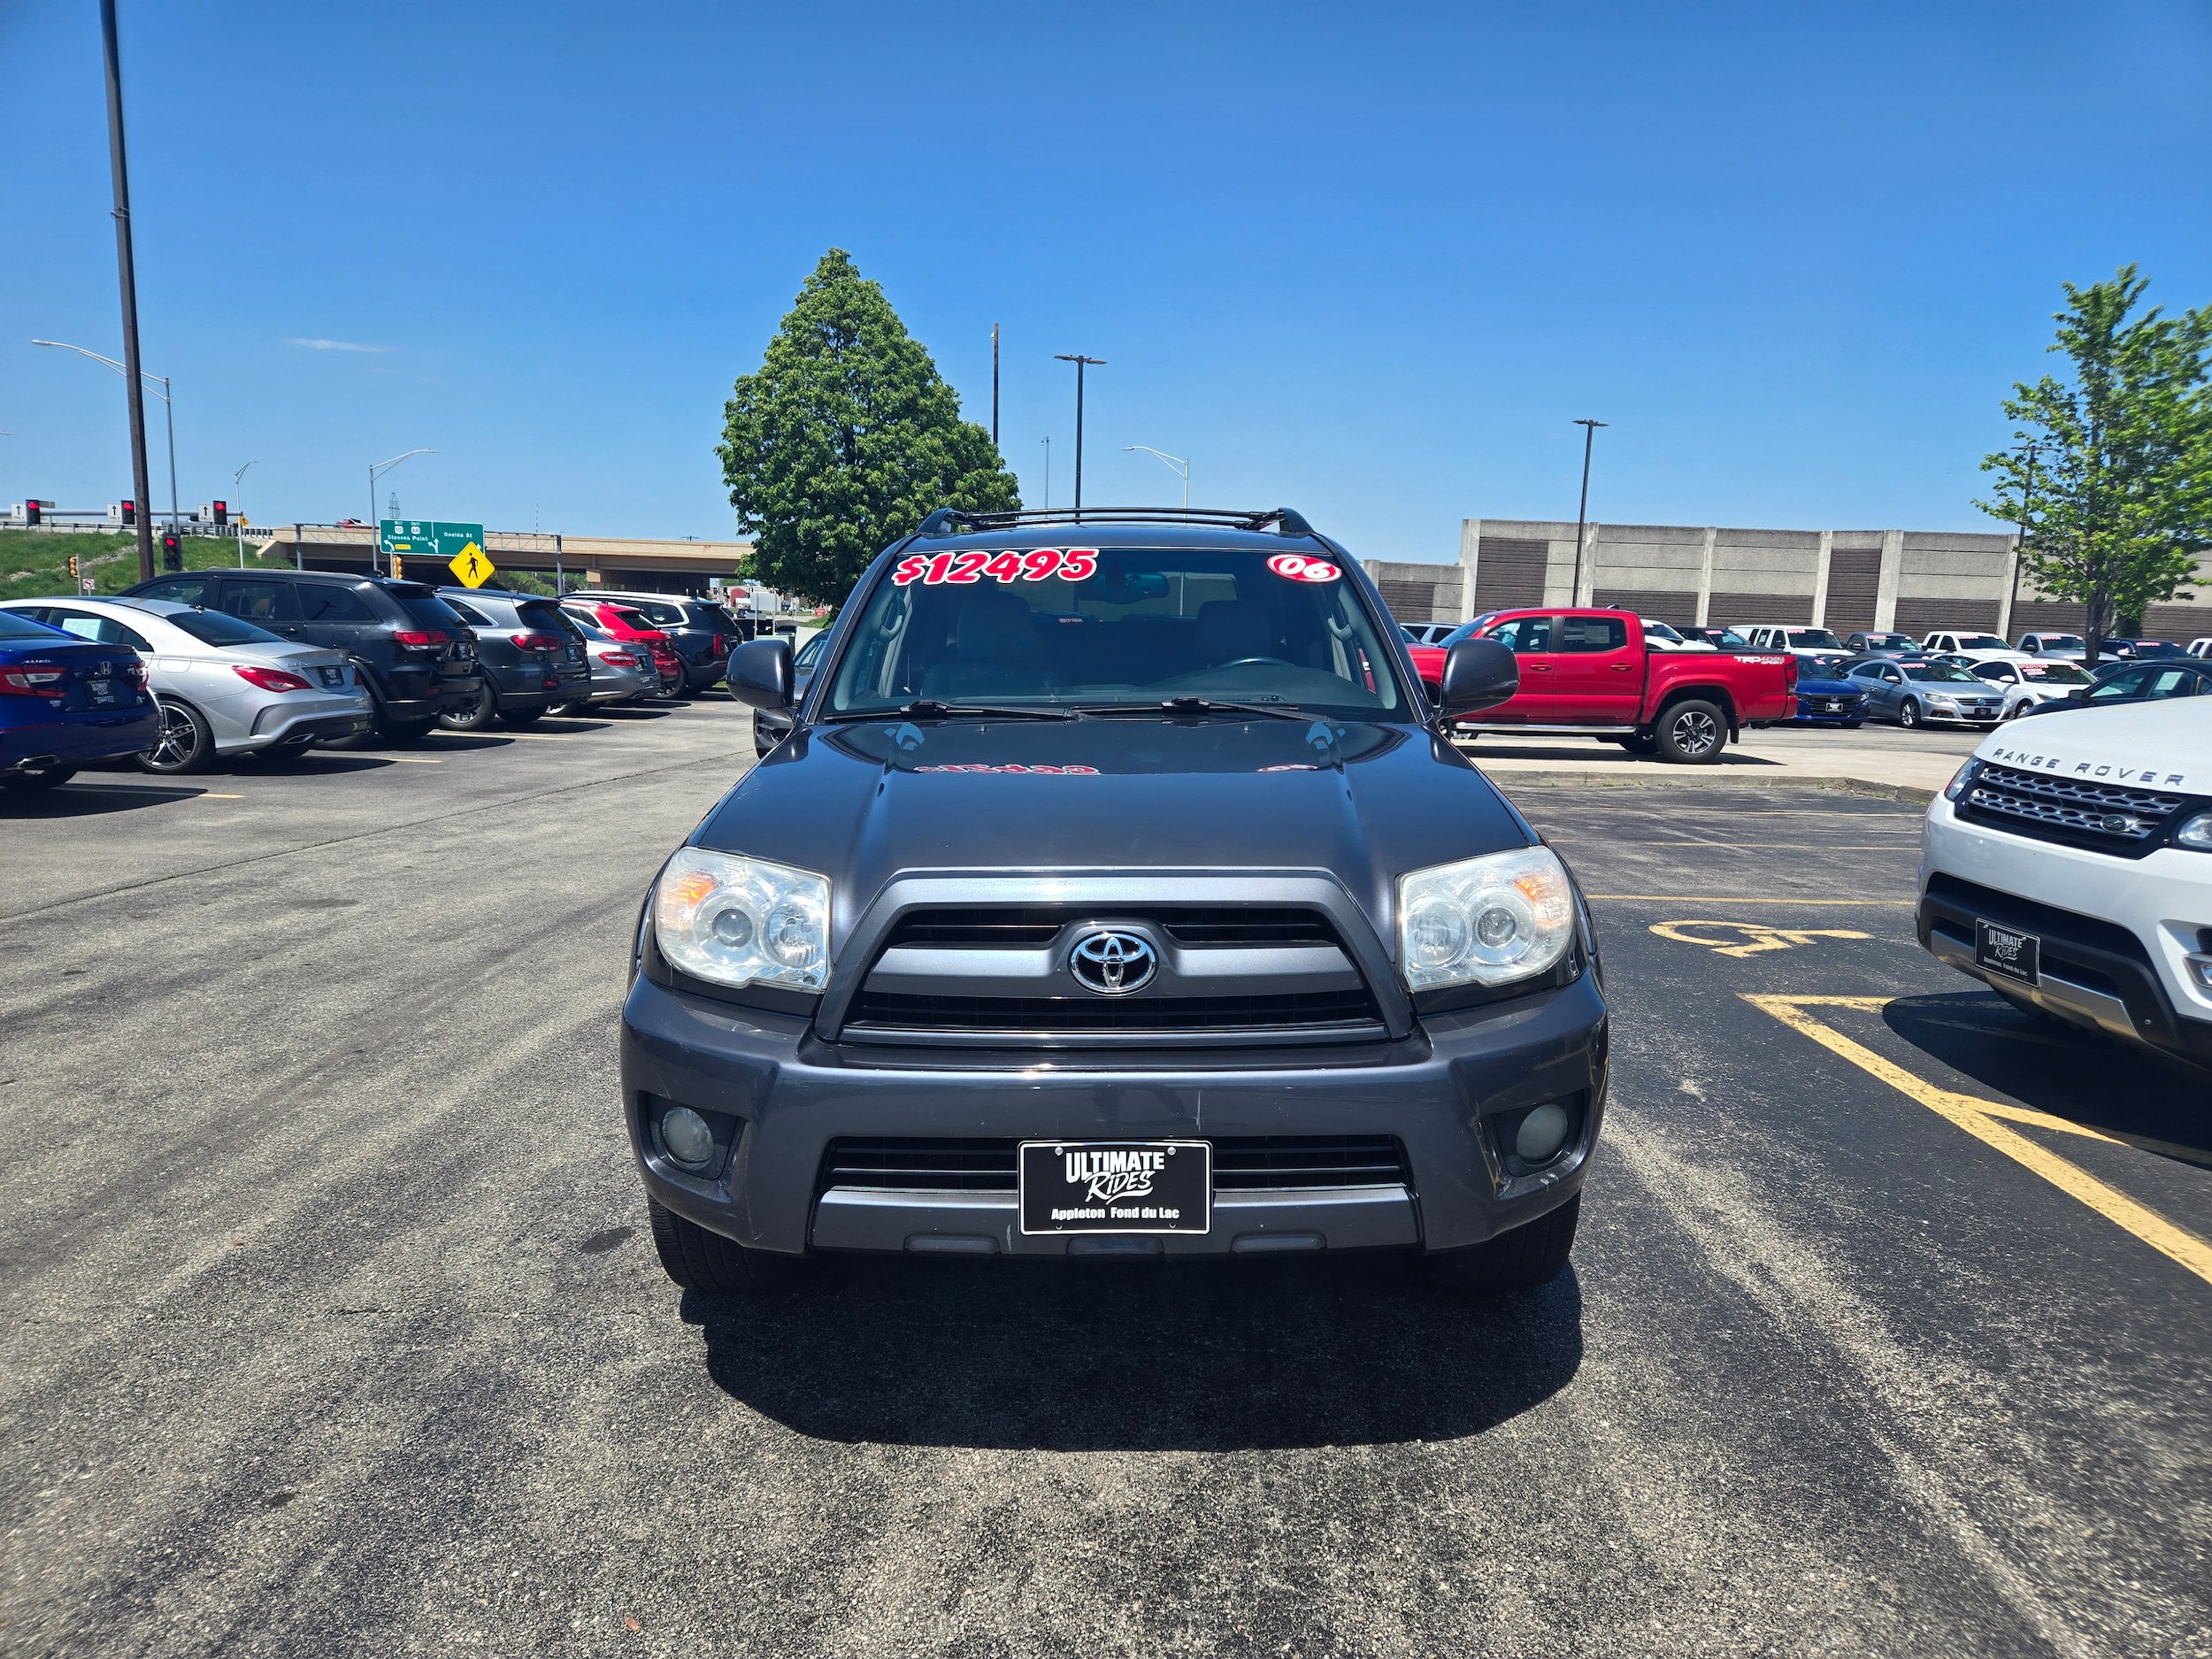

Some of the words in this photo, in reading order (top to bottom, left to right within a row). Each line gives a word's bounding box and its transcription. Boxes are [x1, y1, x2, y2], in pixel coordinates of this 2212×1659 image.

[891, 549, 1099, 586] $12495
[1278, 557, 1333, 580] 06
[1993, 748, 2060, 769] RANGE
[2075, 763, 2185, 786] ROVER
[1988, 928, 2023, 949] ULTIMATE
[1065, 1151, 1165, 1184] ULTIMATE
[1051, 1208, 1105, 1220] Appleton
[1110, 1207, 1139, 1218] Fond
[1141, 1207, 1156, 1218] du
[1159, 1207, 1180, 1219] Lac
